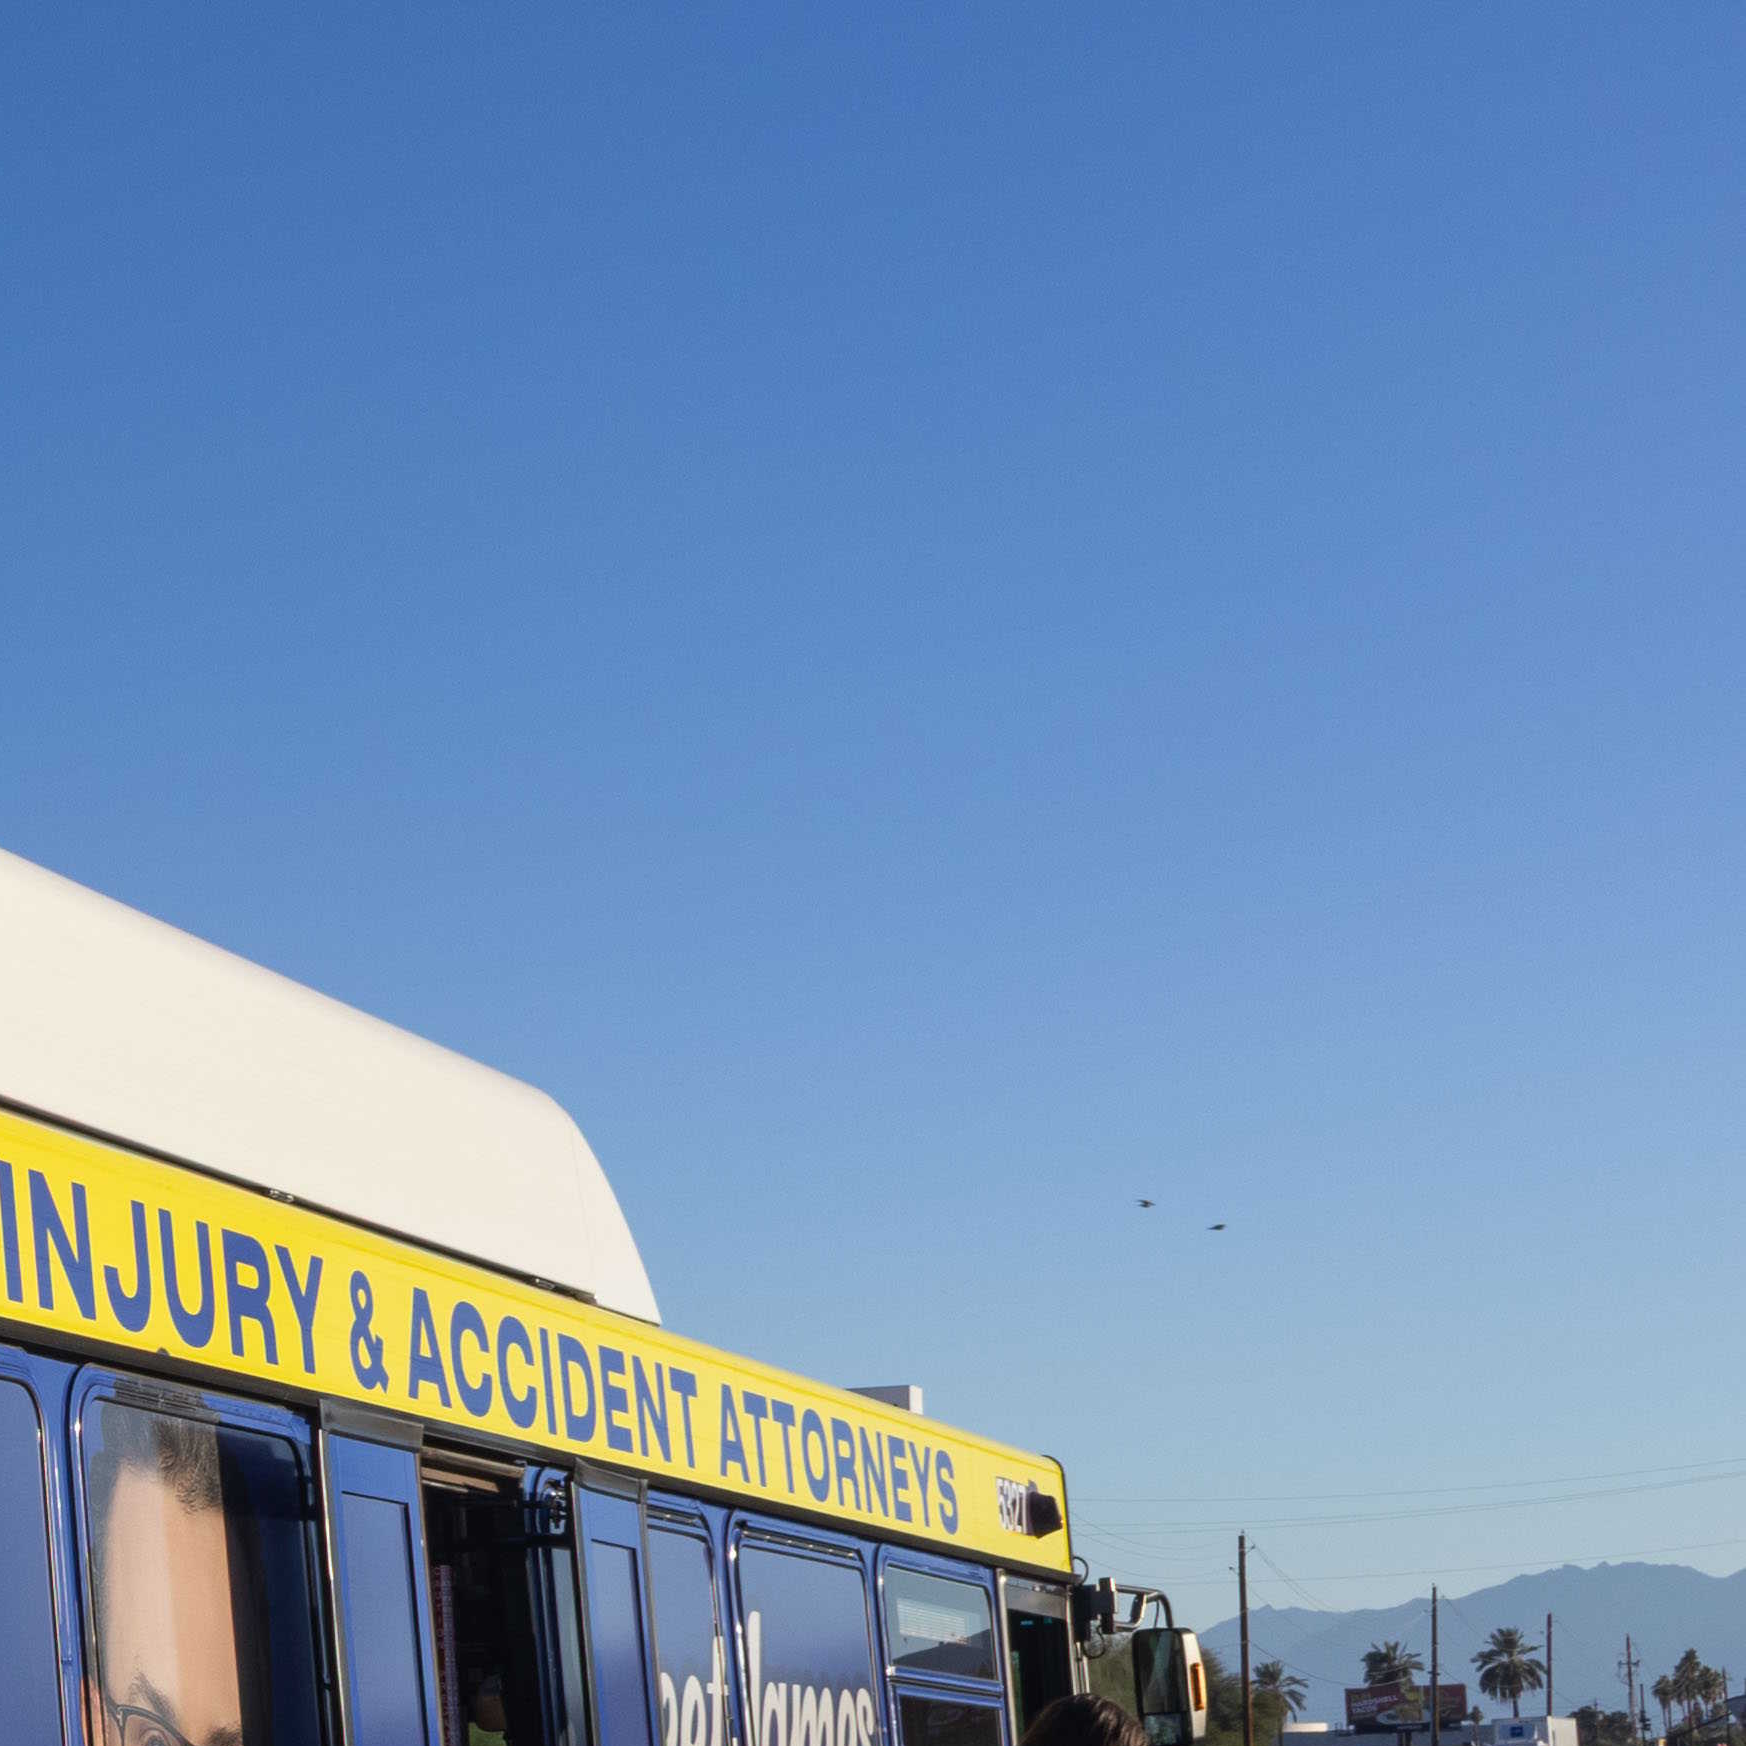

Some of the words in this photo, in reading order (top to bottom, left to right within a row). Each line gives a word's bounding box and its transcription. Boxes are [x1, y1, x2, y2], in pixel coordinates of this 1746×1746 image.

[349, 1270, 389, 1395] &
[407, 1286, 698, 1469] ACCIDENT
[719, 1383, 960, 1536] ATTORNEYS
